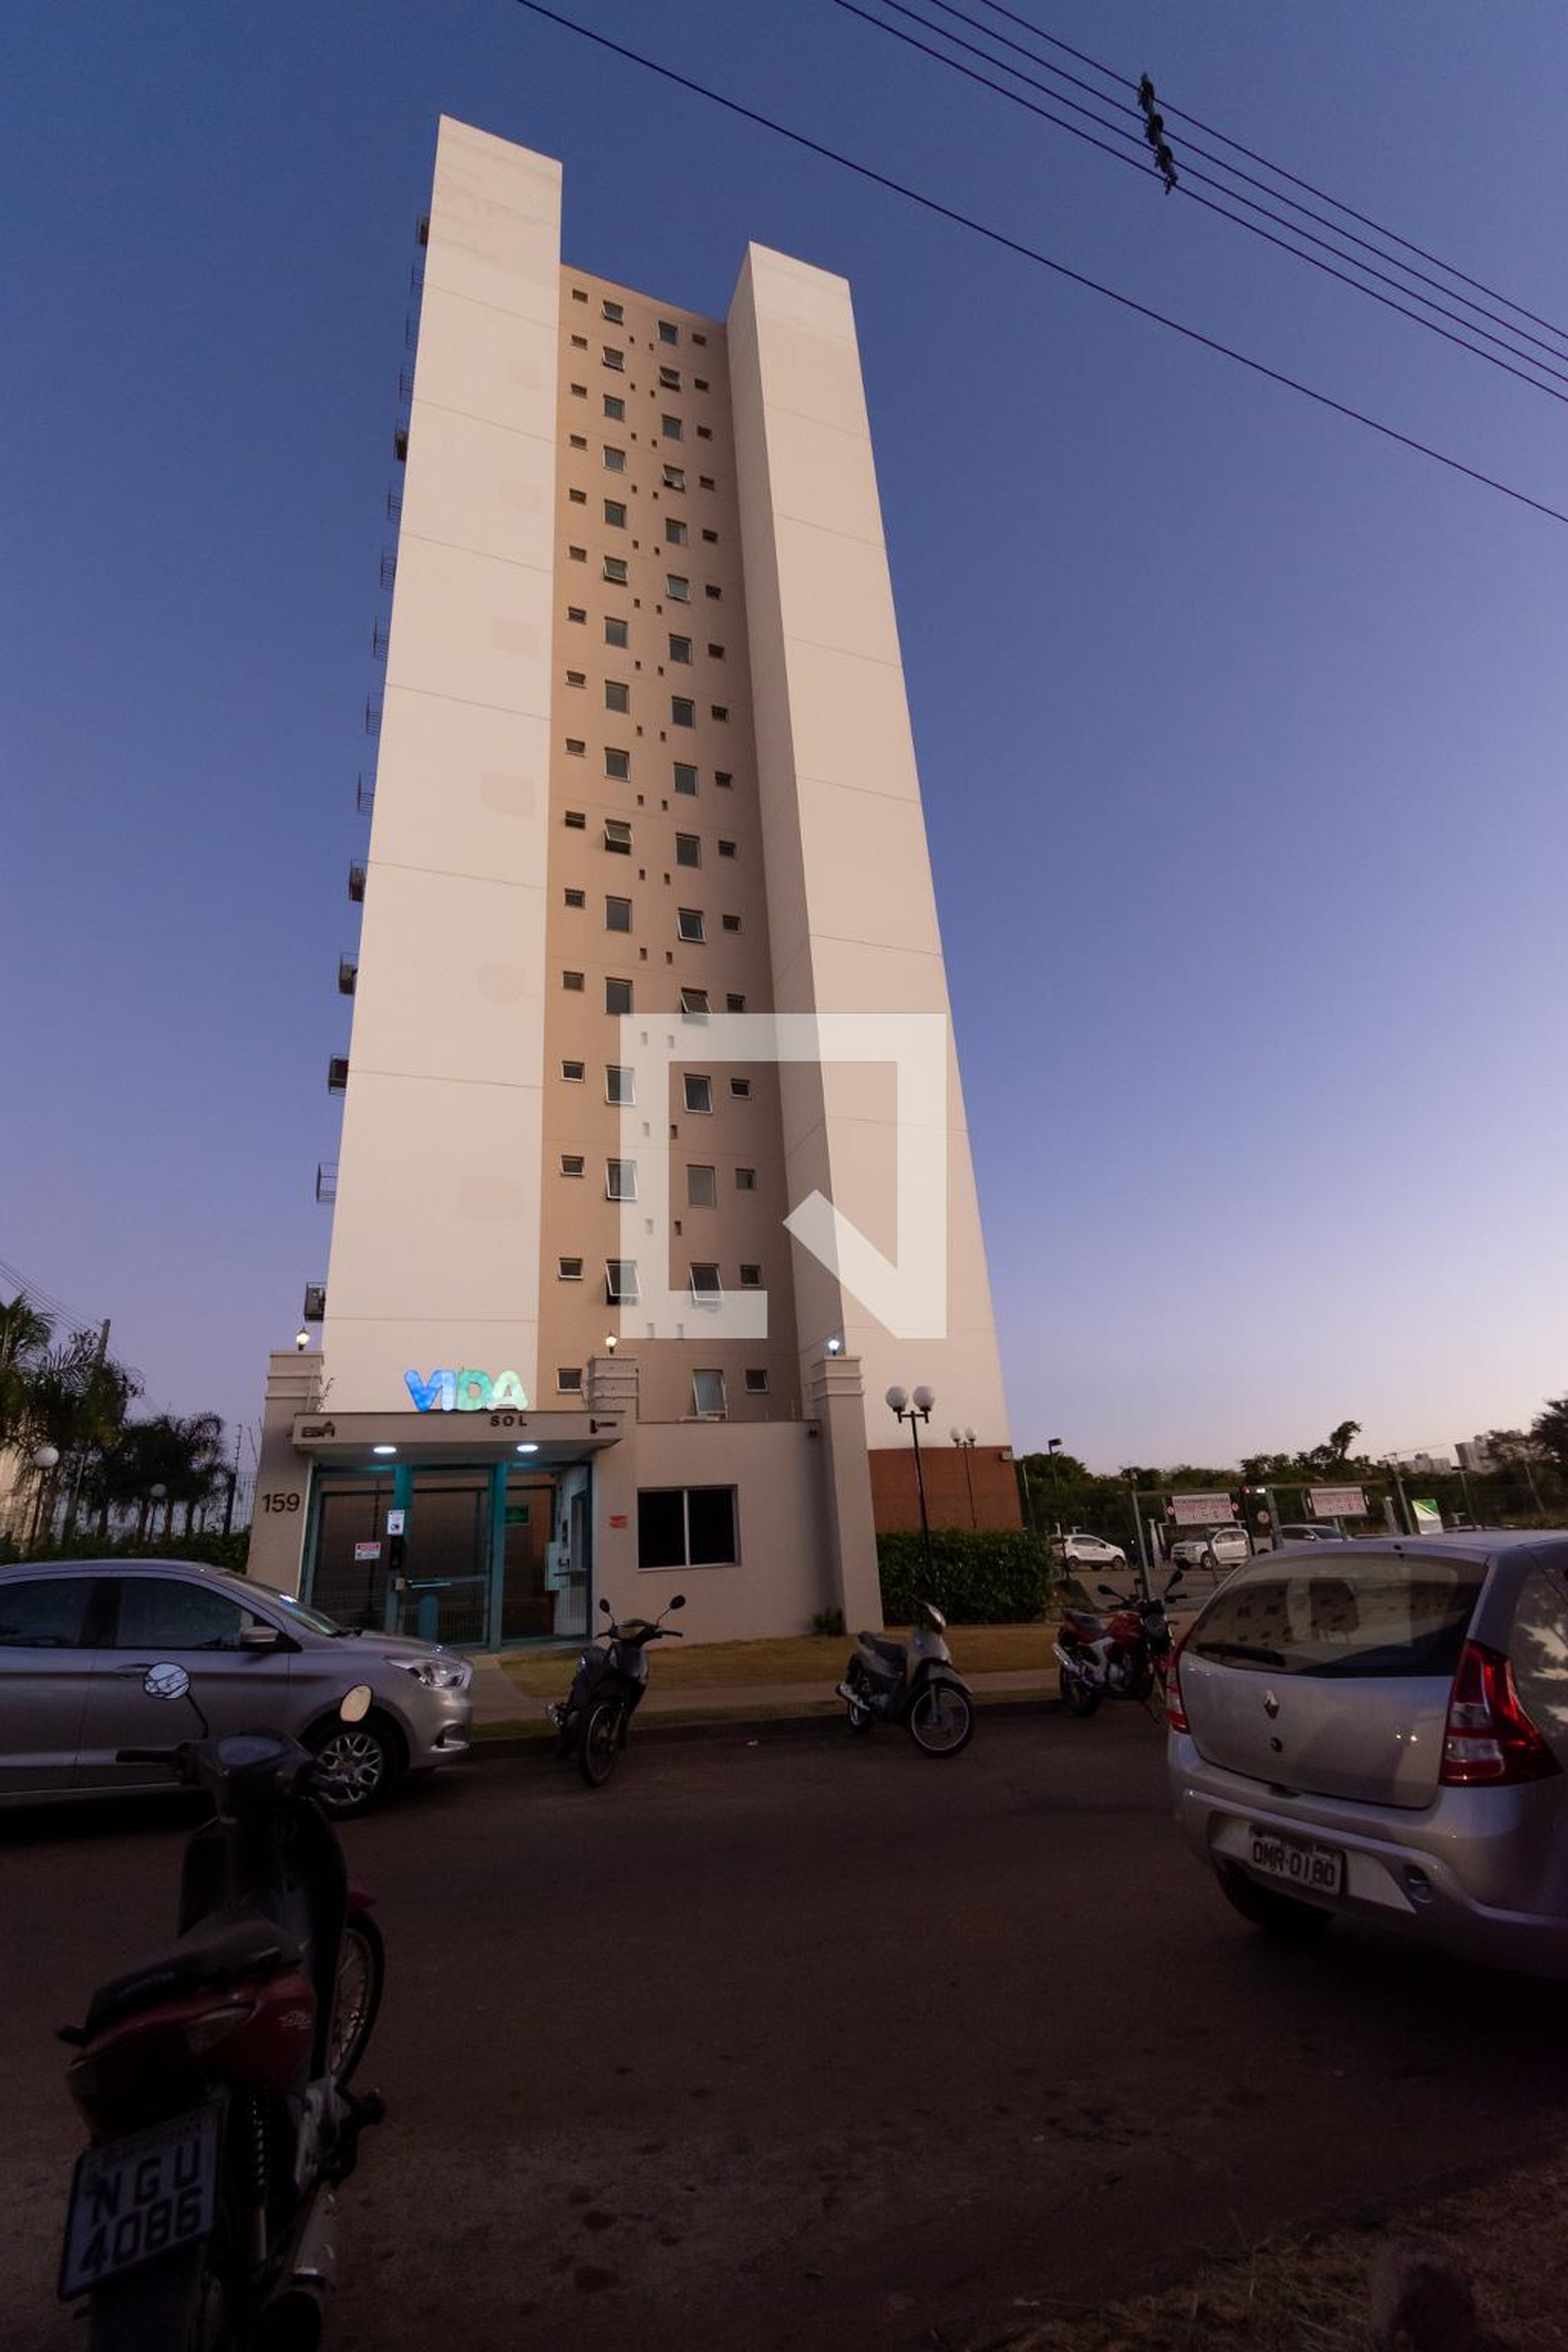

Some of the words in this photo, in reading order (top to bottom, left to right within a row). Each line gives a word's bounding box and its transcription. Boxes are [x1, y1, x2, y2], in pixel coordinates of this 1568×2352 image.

[404, 1370, 528, 1412] VIDA
[490, 1415, 527, 1425] SOL
[261, 1493, 300, 1513] 159
[91, 2139, 201, 2225] NGU
[80, 2187, 202, 2273] 4086
